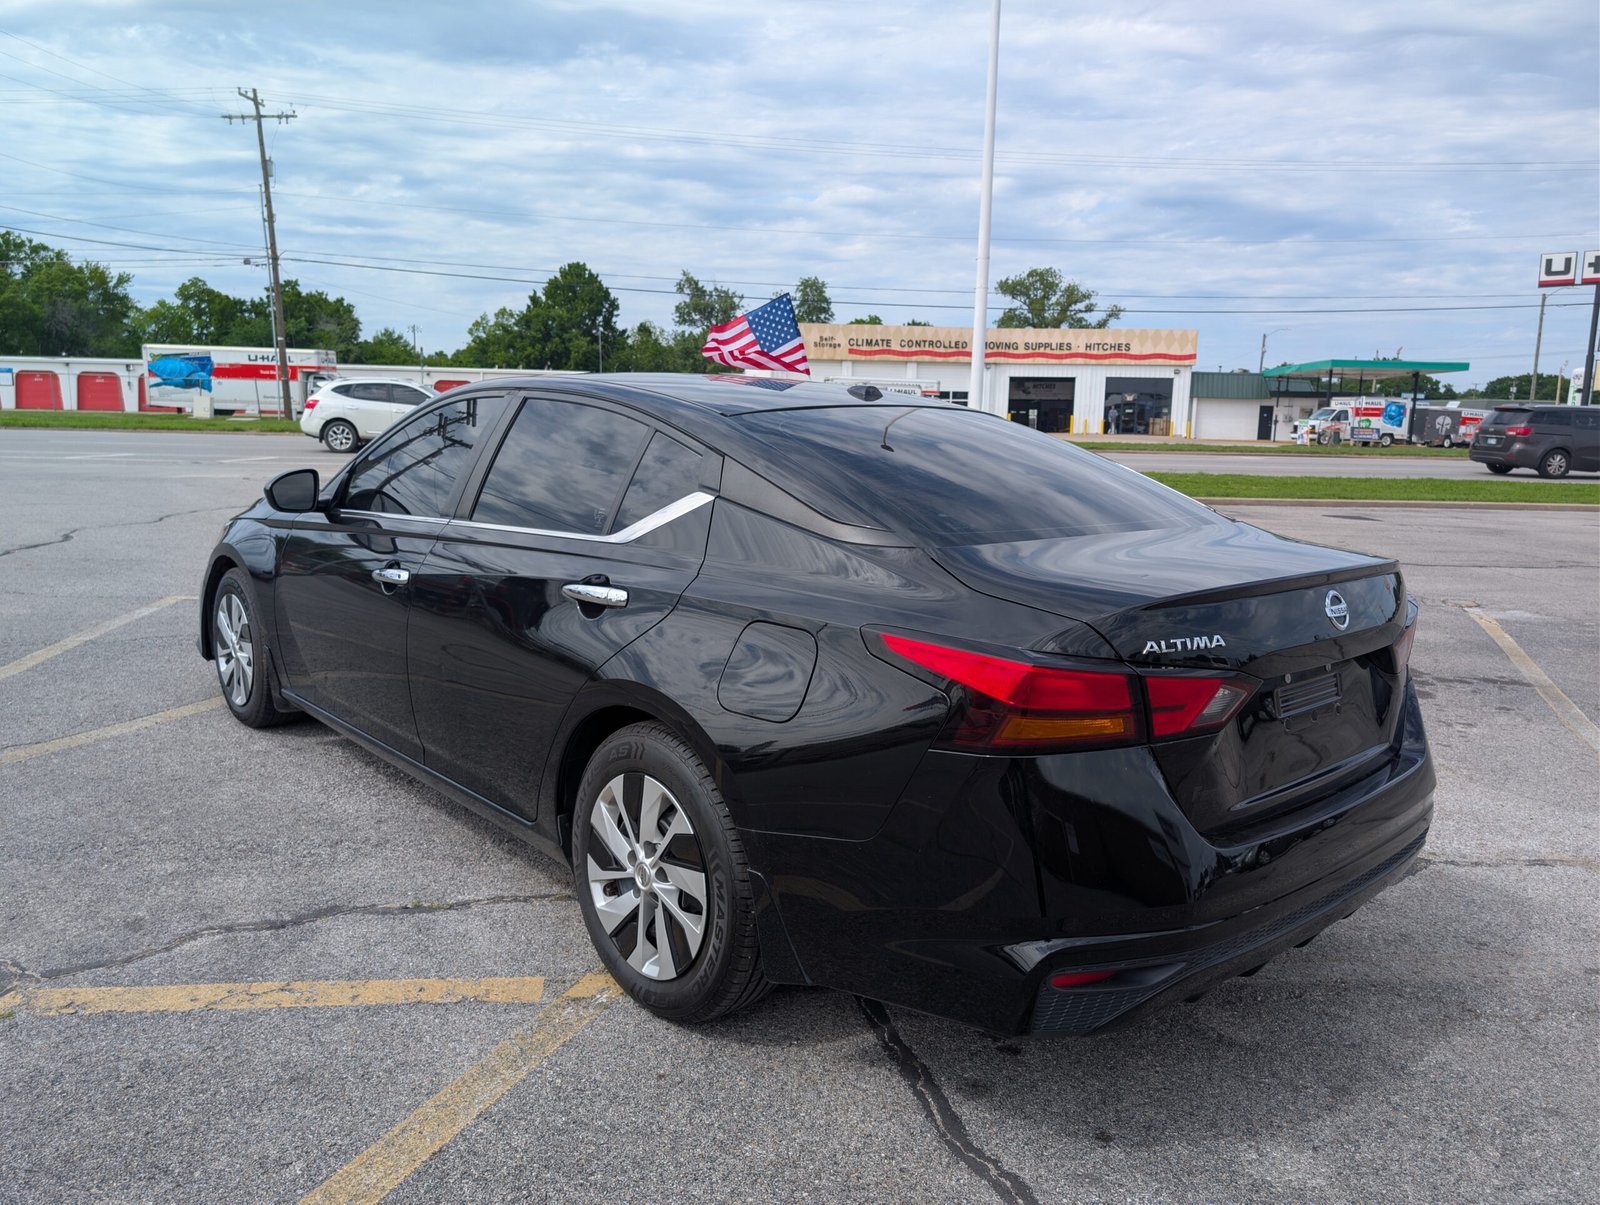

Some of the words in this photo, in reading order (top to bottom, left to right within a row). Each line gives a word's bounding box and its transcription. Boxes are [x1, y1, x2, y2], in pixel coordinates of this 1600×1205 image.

[848, 337, 892, 348] CLIMATE
[900, 340, 968, 349] CONTROLLED
[1024, 342, 1072, 351] SUPPLIES
[1085, 342, 1131, 352] HITCHES
[247, 354, 294, 363] U-HAL
[1142, 634, 1226, 655] ALTIMA
